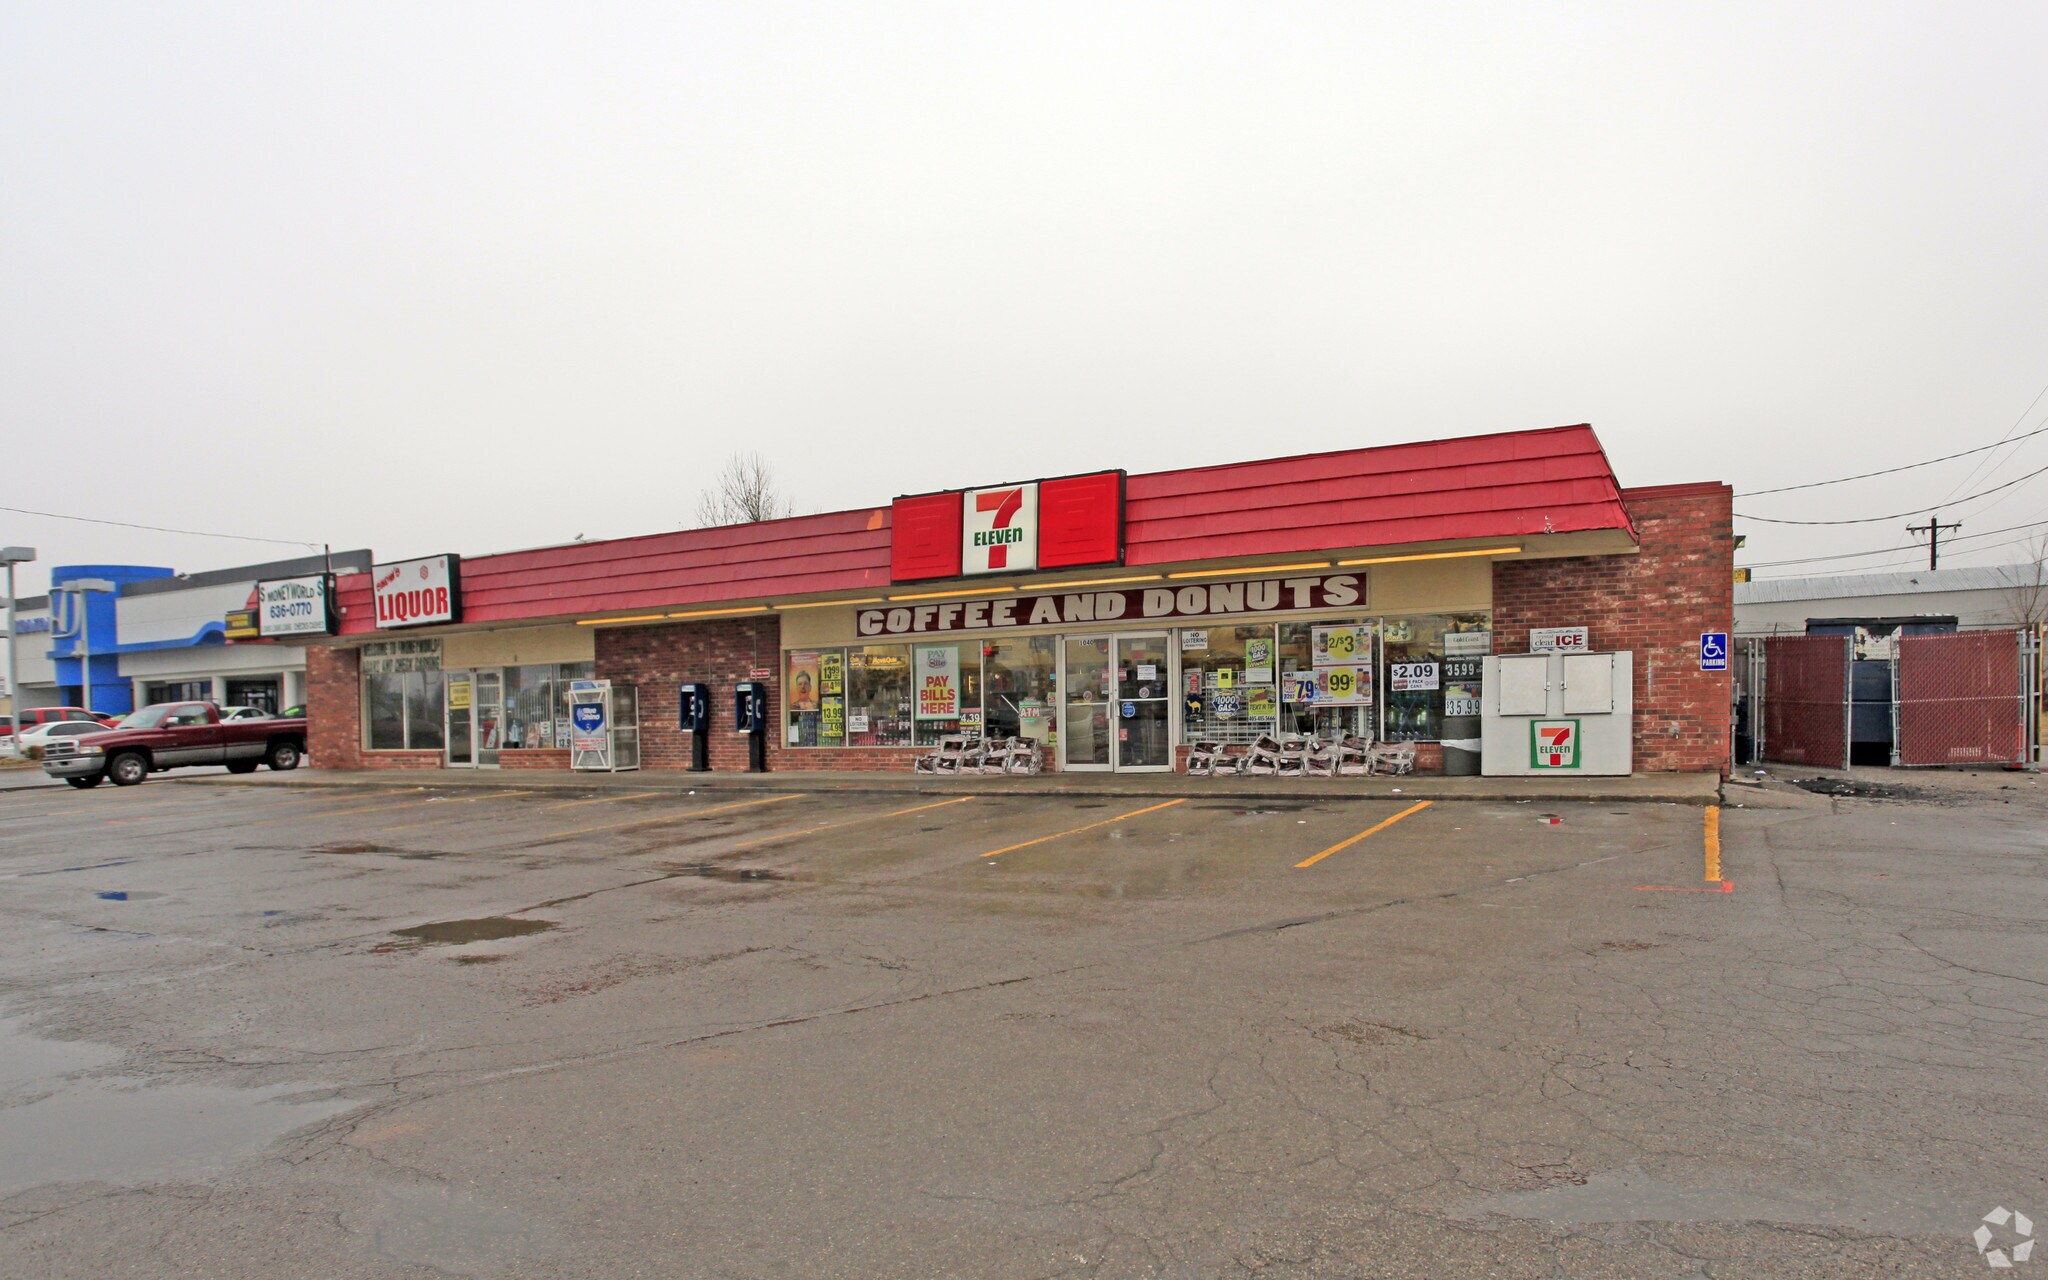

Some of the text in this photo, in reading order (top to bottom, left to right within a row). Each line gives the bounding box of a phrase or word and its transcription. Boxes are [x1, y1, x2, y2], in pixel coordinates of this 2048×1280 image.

[976, 487, 1022, 569] 7
[270, 602, 312, 618] 636-0770
[378, 587, 448, 621] LIQUOR
[859, 575, 1359, 635] COFFEE AND DONUTS
[1329, 635, 1354, 652] 2/$3
[1555, 634, 1583, 646] ICE
[927, 649, 946, 658] PAY
[1393, 665, 1433, 678] $2.09
[926, 676, 949, 687] PAY
[920, 689, 956, 701] BILLS
[823, 708, 842, 718] 13.99
[920, 702, 955, 714] HERE
[1019, 706, 1040, 717] ATM
[1540, 727, 1570, 766] 7
